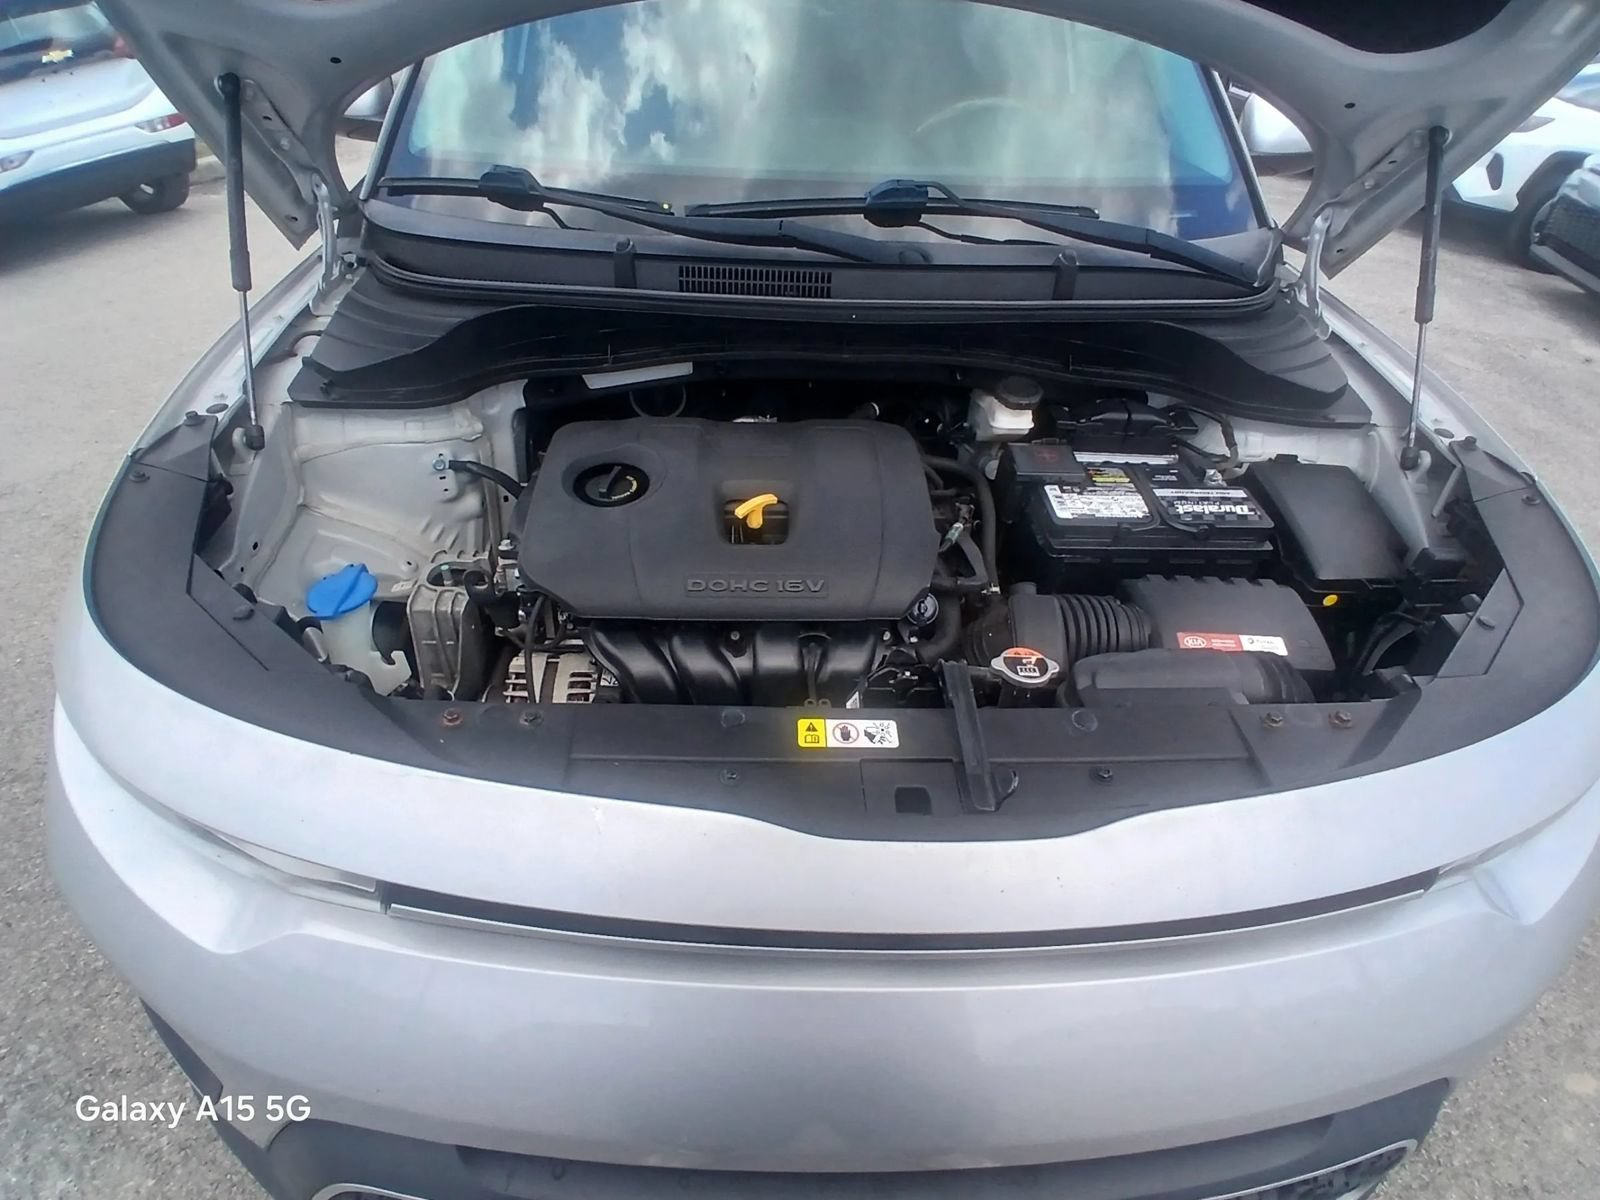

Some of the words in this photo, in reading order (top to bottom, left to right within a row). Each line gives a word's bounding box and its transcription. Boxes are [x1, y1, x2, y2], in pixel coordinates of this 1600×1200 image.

[1175, 504, 1255, 515] Duralast
[687, 579, 769, 593] DOHC
[777, 579, 825, 593] 16V
